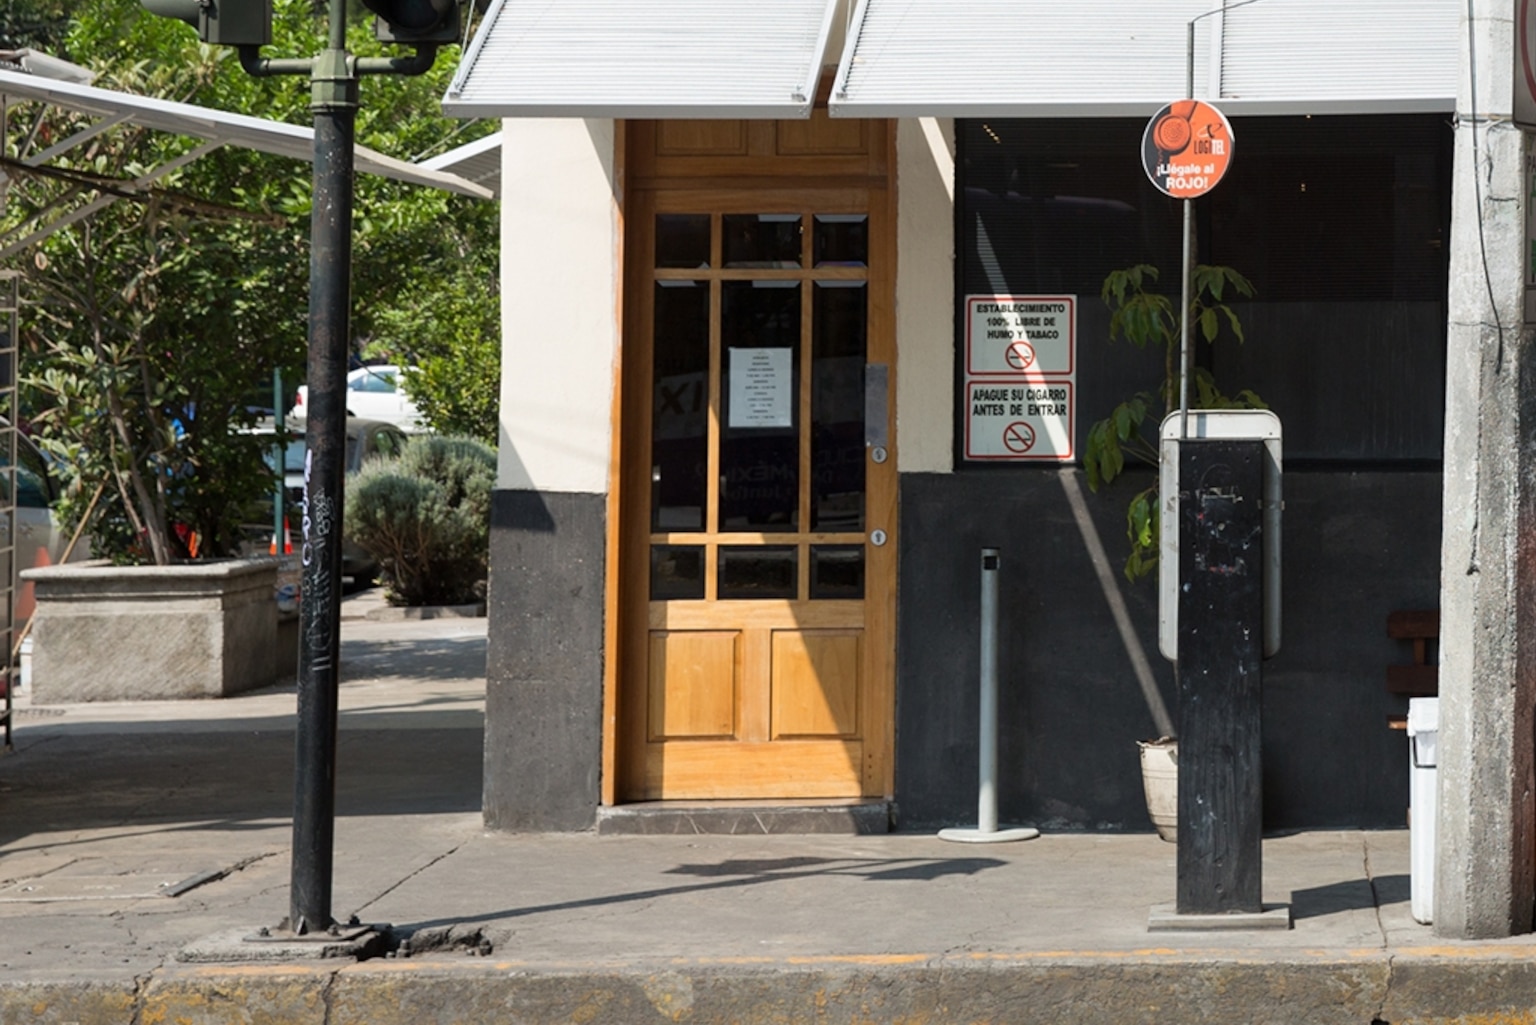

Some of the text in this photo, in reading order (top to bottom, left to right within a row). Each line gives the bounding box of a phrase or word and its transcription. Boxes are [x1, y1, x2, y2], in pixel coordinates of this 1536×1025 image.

[1203, 163, 1214, 174] al
[1166, 177, 1208, 189] ROJO!
[976, 304, 1065, 314] ESTABLECIMIENTO
[1015, 317, 1041, 327] LIBRE
[1044, 317, 1056, 326] DE
[987, 330, 1059, 339] HUMO Y TABACO
[973, 389, 1066, 401] APAGUE SU CIGARRO
[972, 404, 1066, 416] ANTES DE ENTRAR
